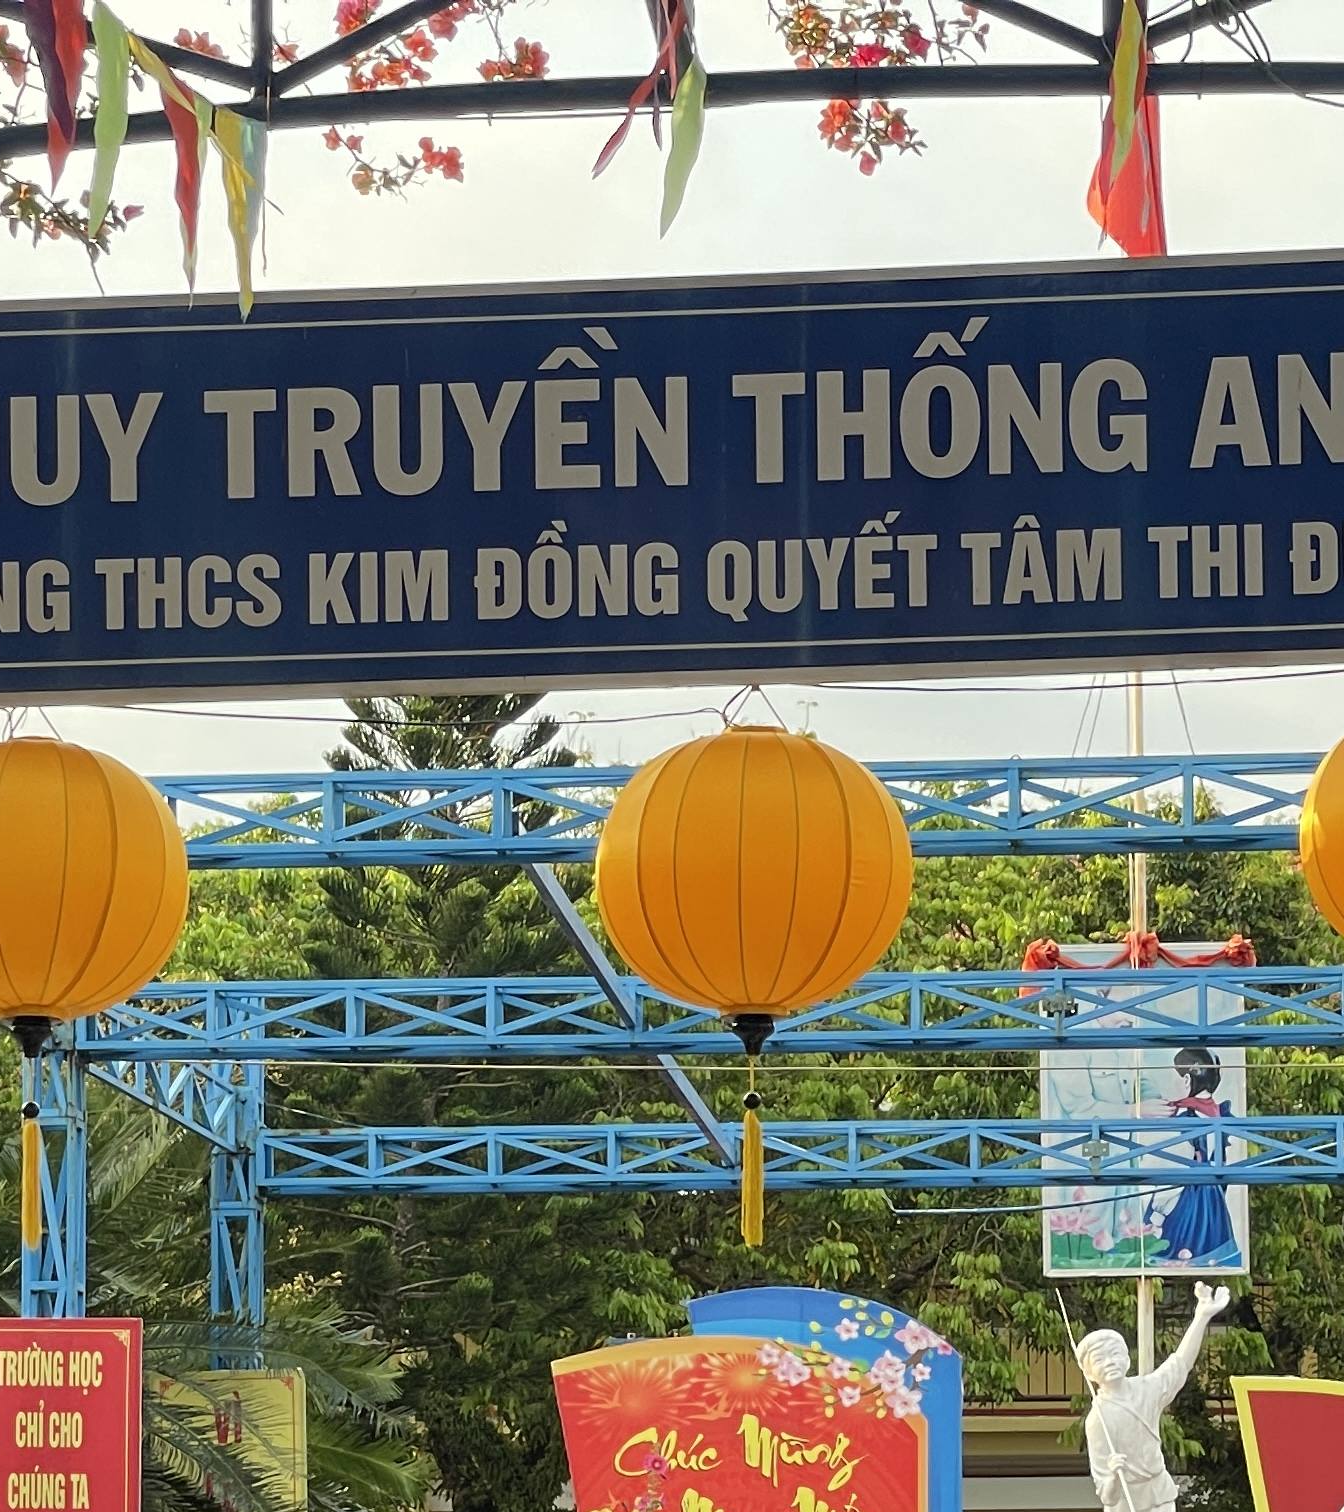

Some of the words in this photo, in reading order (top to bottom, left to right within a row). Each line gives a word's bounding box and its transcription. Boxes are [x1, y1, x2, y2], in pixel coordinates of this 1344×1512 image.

[204, 327, 688, 498] TRUYỀN
[733, 317, 1147, 483] THỐNG
[95, 554, 281, 629] THCS
[309, 550, 448, 624] KIM
[474, 521, 678, 619] ĐỒNG
[708, 511, 937, 621] QUYẾT
[961, 515, 1121, 605] TÂM
[1148, 524, 1263, 598] THI
[69, 1351, 102, 1395] HỌC
[16, 1400, 44, 1447] CHỈ
[49, 1412, 82, 1448] CHO
[614, 1427, 723, 1477] Chúc
[737, 1414, 870, 1491] Mừng
[8, 1465, 65, 1509] CHÚNG
[71, 1474, 89, 1509] TA
